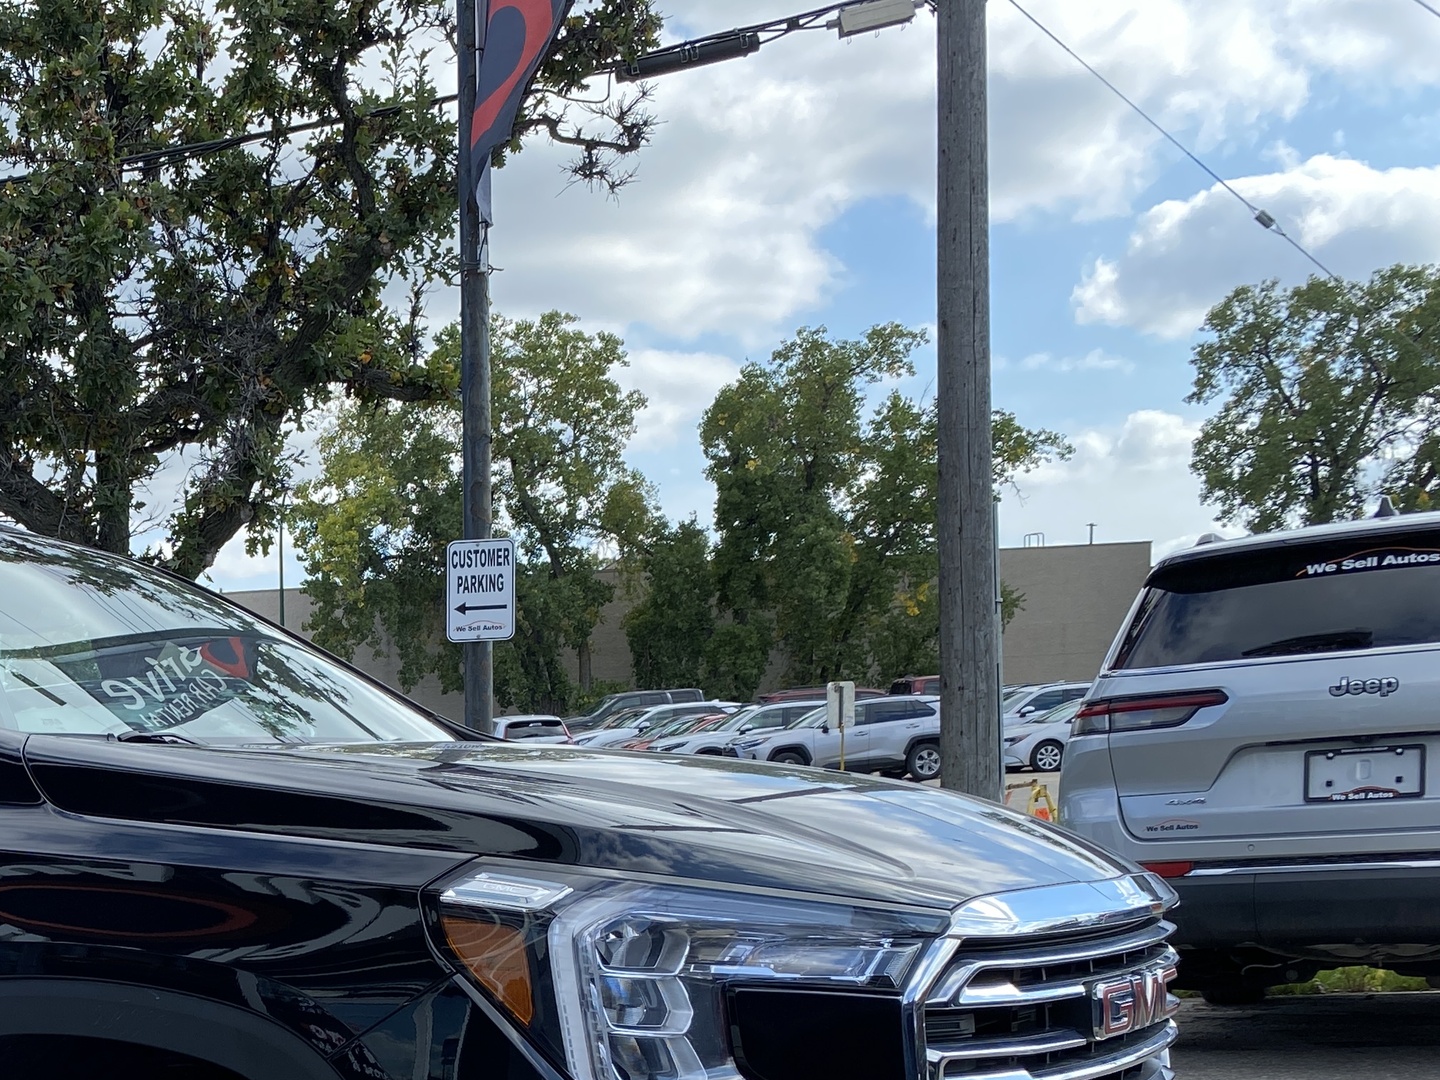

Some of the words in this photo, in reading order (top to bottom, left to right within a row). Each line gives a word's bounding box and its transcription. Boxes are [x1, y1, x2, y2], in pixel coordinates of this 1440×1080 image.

[451, 547, 510, 569] CUSTOMER
[1306, 562, 1337, 575] We
[1341, 556, 1379, 570] Sell
[1381, 553, 1440, 566] Autos
[457, 573, 504, 594] PARKING
[1329, 676, 1399, 698] Jeep
[482, 882, 522, 893] GMC
[1097, 966, 1180, 1039] GMC
